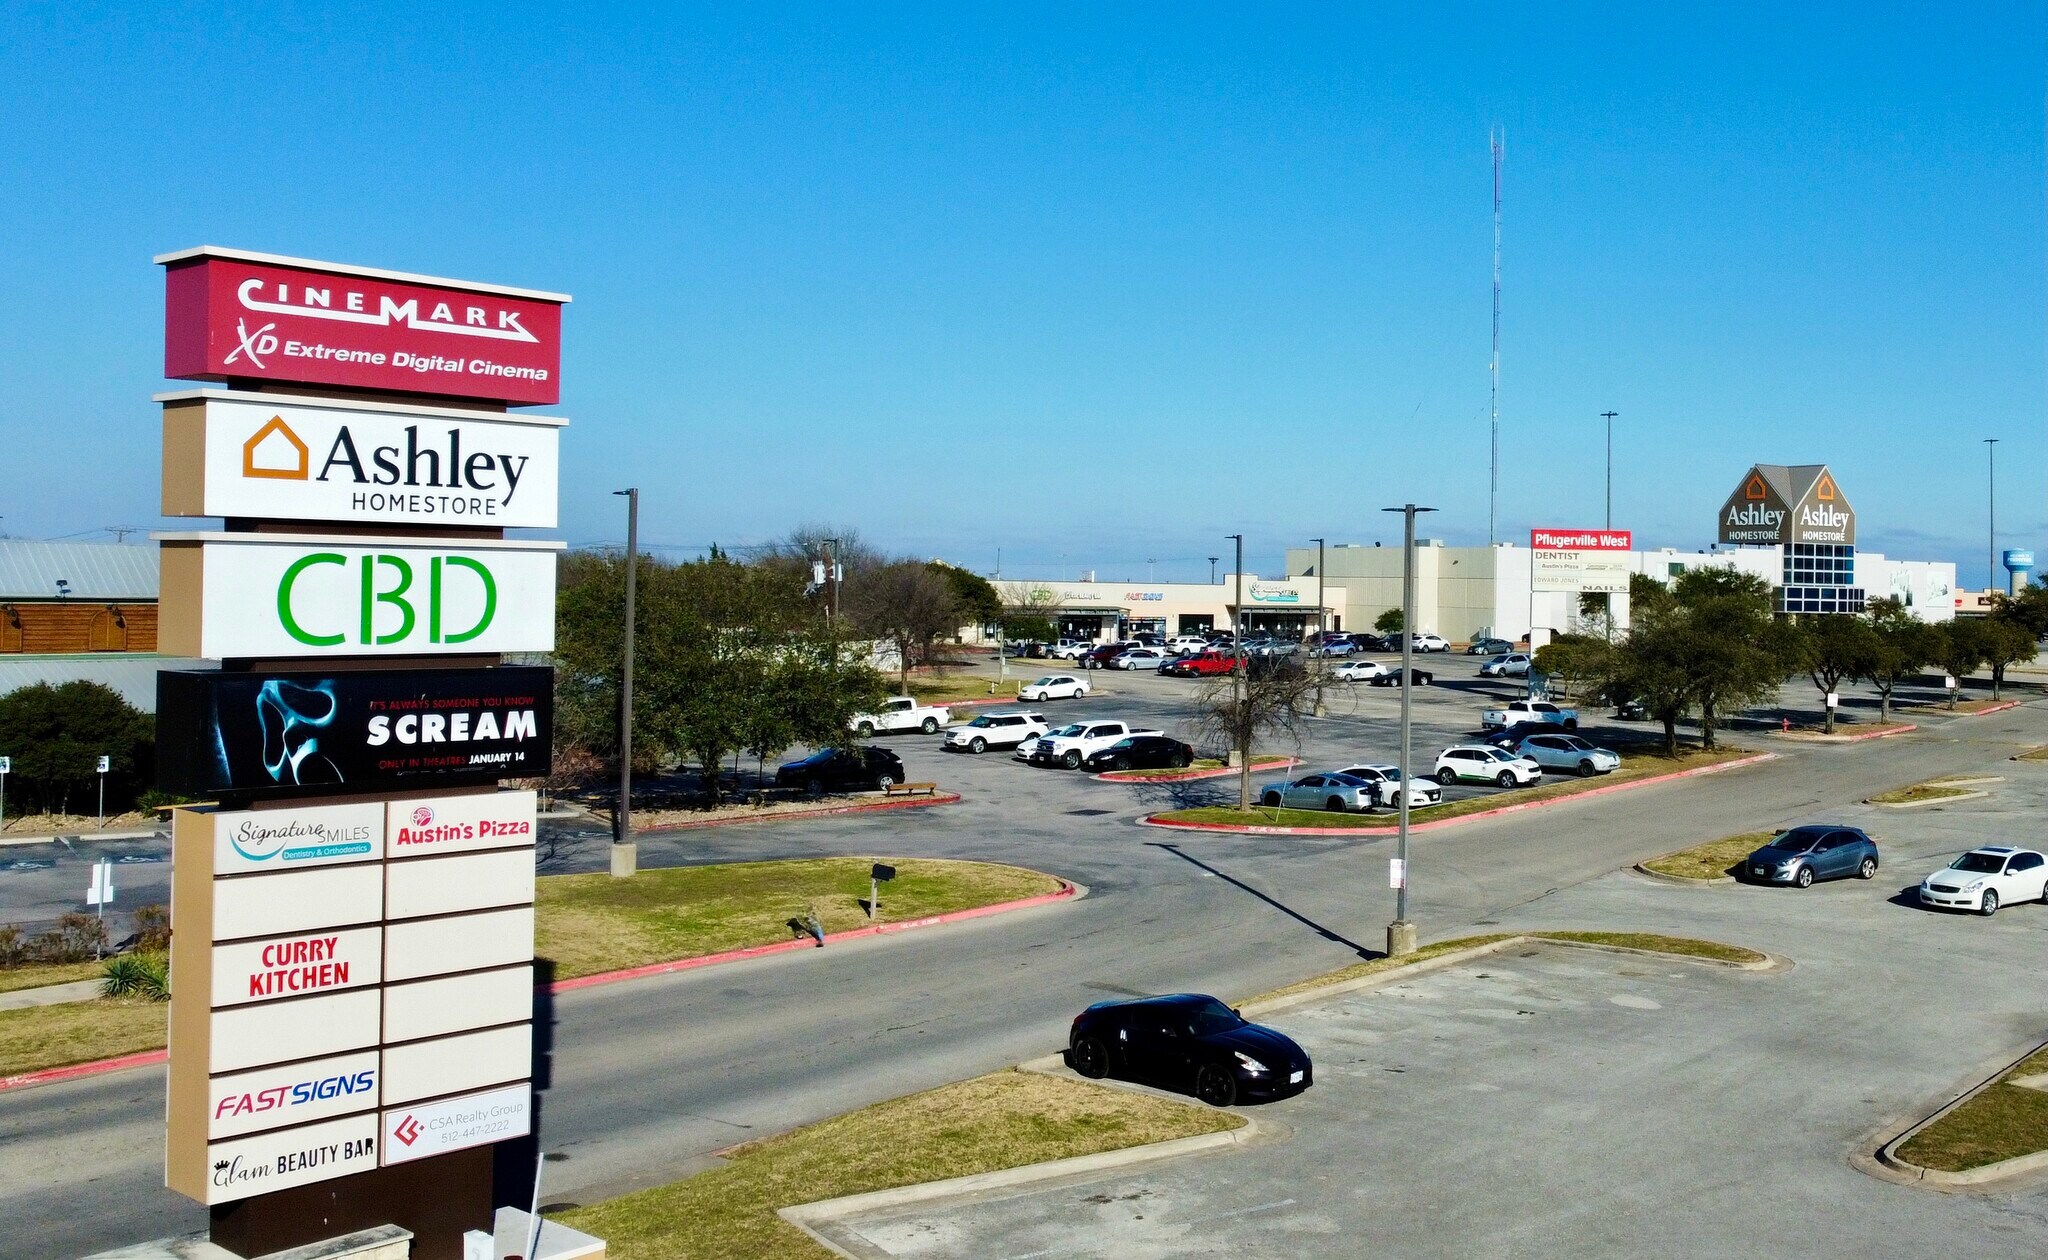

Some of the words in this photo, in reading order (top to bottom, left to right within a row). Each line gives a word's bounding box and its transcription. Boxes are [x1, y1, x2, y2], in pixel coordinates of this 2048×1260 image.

[237, 278, 540, 343] CINEMARK
[224, 317, 278, 369] XD
[284, 340, 386, 366] Extreme
[392, 351, 464, 374] Digital
[469, 359, 548, 381] Cinema
[316, 425, 529, 507] Ashley
[352, 492, 497, 516] HOMESTORE
[1726, 502, 1786, 530] Ashley
[1800, 503, 1849, 532] Ashley
[1535, 533, 1598, 548] Pflugerville
[1599, 535, 1628, 547] West
[1729, 530, 1780, 540] HOMESTORE
[1802, 530, 1845, 541] HOMESTORE
[1535, 551, 1580, 560] DENTIST
[277, 552, 497, 647] CBD
[389, 700, 430, 711] ALWAYS
[432, 698, 479, 709] SOMEONE
[482, 697, 501, 707] YOU
[504, 696, 535, 706] KNOW
[366, 710, 537, 747] SCREAM
[379, 759, 405, 770] ONLY
[409, 758, 420, 767] IN
[423, 756, 467, 766] THEATRES
[469, 752, 512, 765] JANUARY
[514, 751, 525, 762] 14
[237, 820, 324, 846] Signature
[317, 826, 370, 844] SMILES
[396, 823, 474, 846] Austin's
[479, 820, 530, 838] Pizza
[283, 848, 316, 860] Dentistry
[316, 848, 323, 856] &
[323, 844, 368, 856] Orthodontics
[261, 937, 339, 968] CURRY
[249, 961, 349, 997] KITCHEN
[214, 1070, 375, 1120] FASTSIGNS
[429, 1115, 454, 1131] CSA
[455, 1109, 489, 1125] Realty
[490, 1103, 523, 1118] Group
[441, 1119, 510, 1144] 512-447-2222
[213, 1154, 274, 1188] Glam
[277, 1143, 339, 1175] BEAUTY
[344, 1137, 374, 1160] BAR
